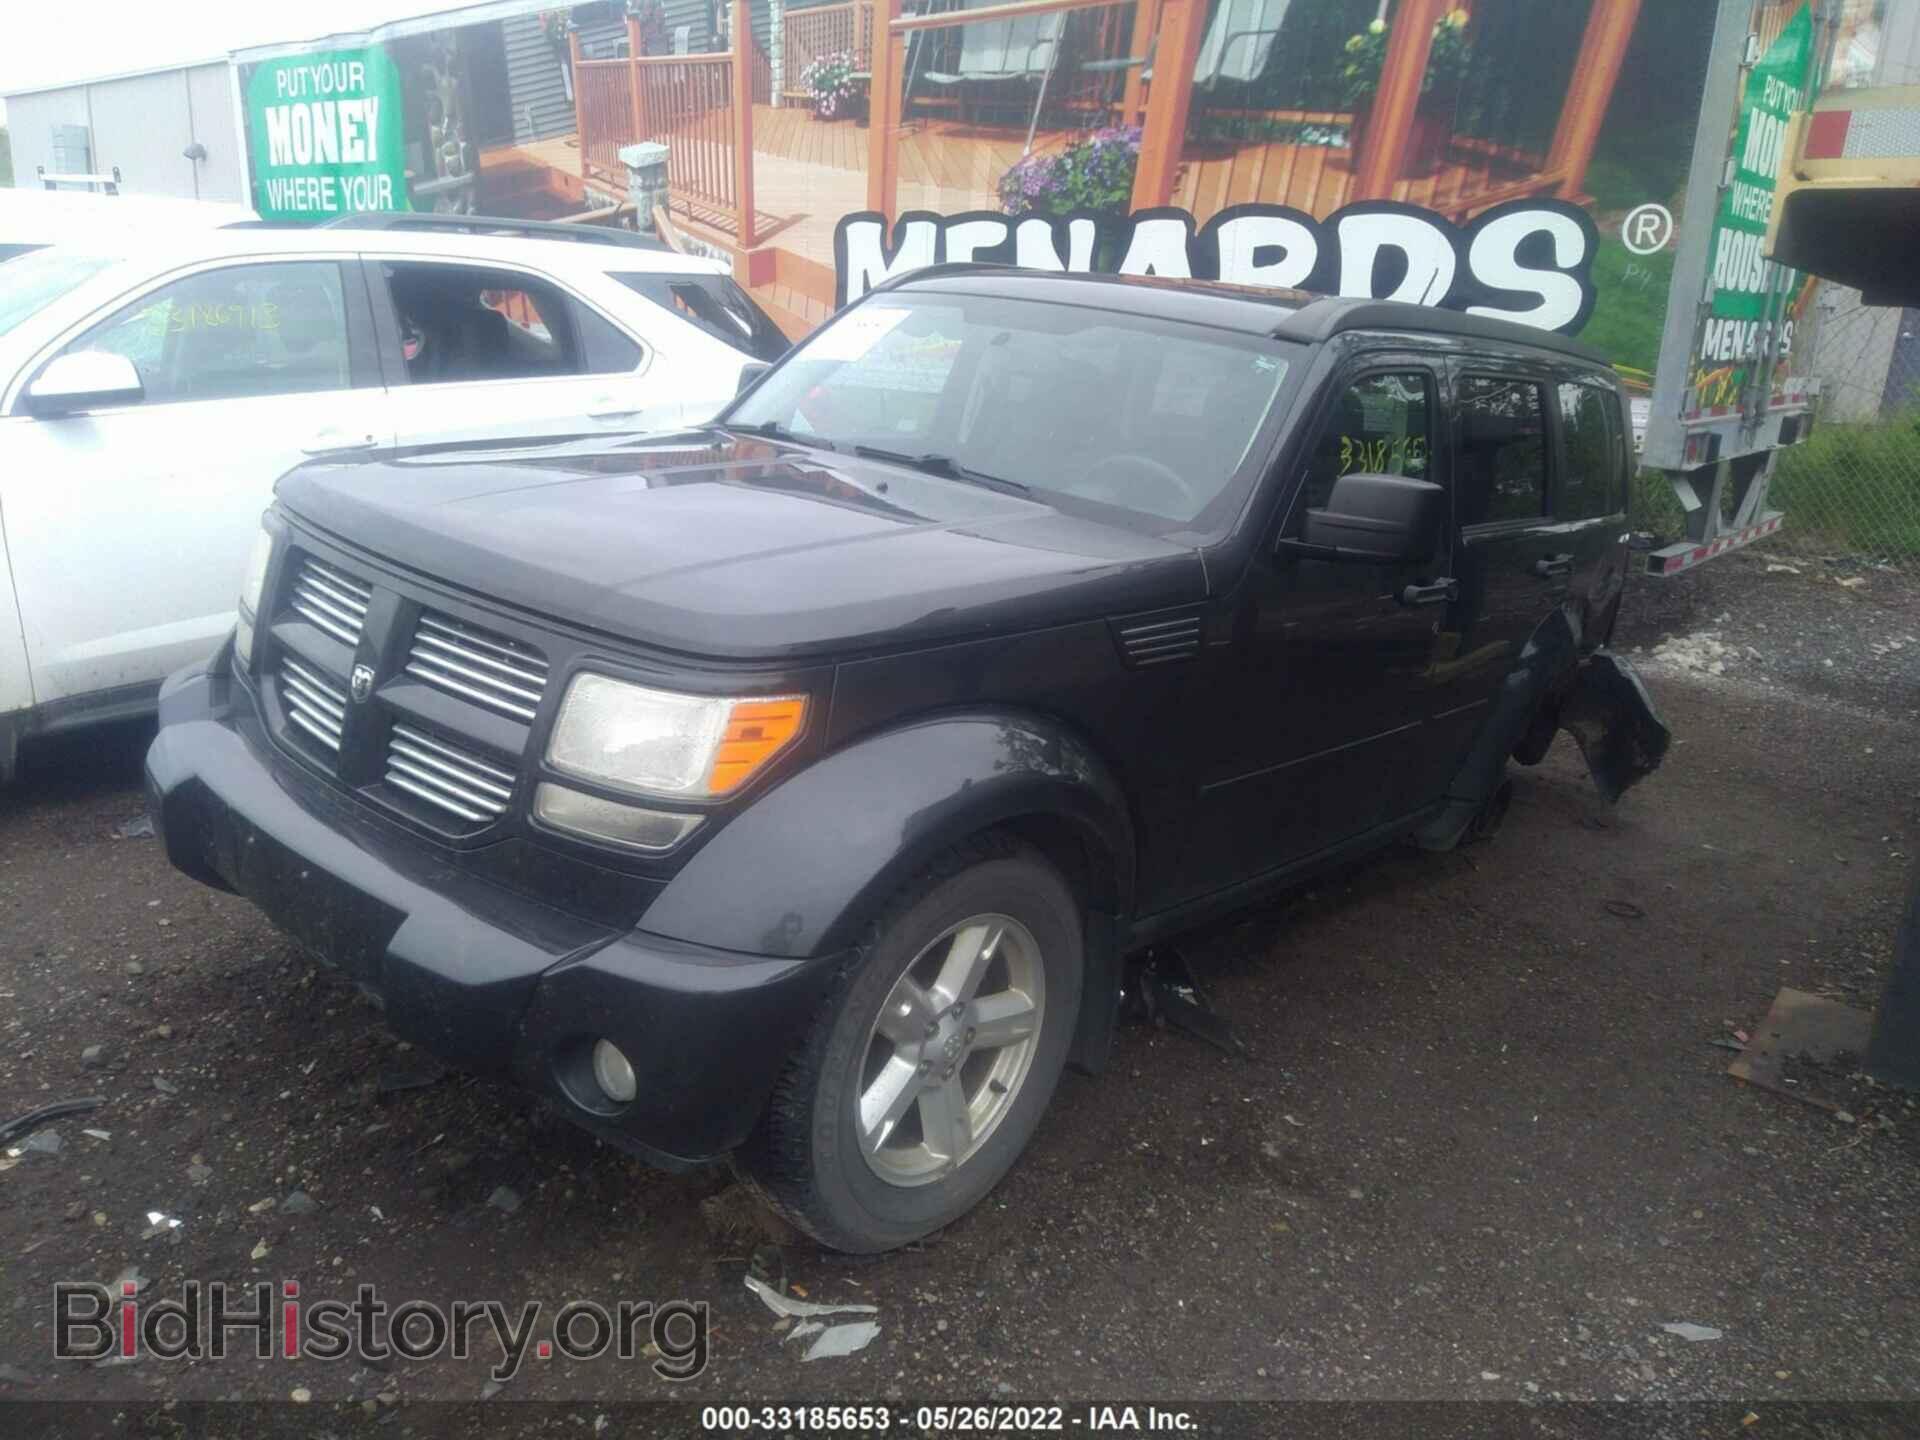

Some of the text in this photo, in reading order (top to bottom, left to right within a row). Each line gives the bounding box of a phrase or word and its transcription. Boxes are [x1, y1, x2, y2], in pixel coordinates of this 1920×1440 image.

[276, 61, 366, 98] PUT YOUR
[1762, 74, 1784, 108] PUT
[265, 95, 379, 168] MONEY
[1741, 106, 1787, 178] MON
[266, 173, 394, 212] WHERE YOUR
[1731, 179, 1774, 225] WHERE
[1701, 318, 1793, 361] MENS
